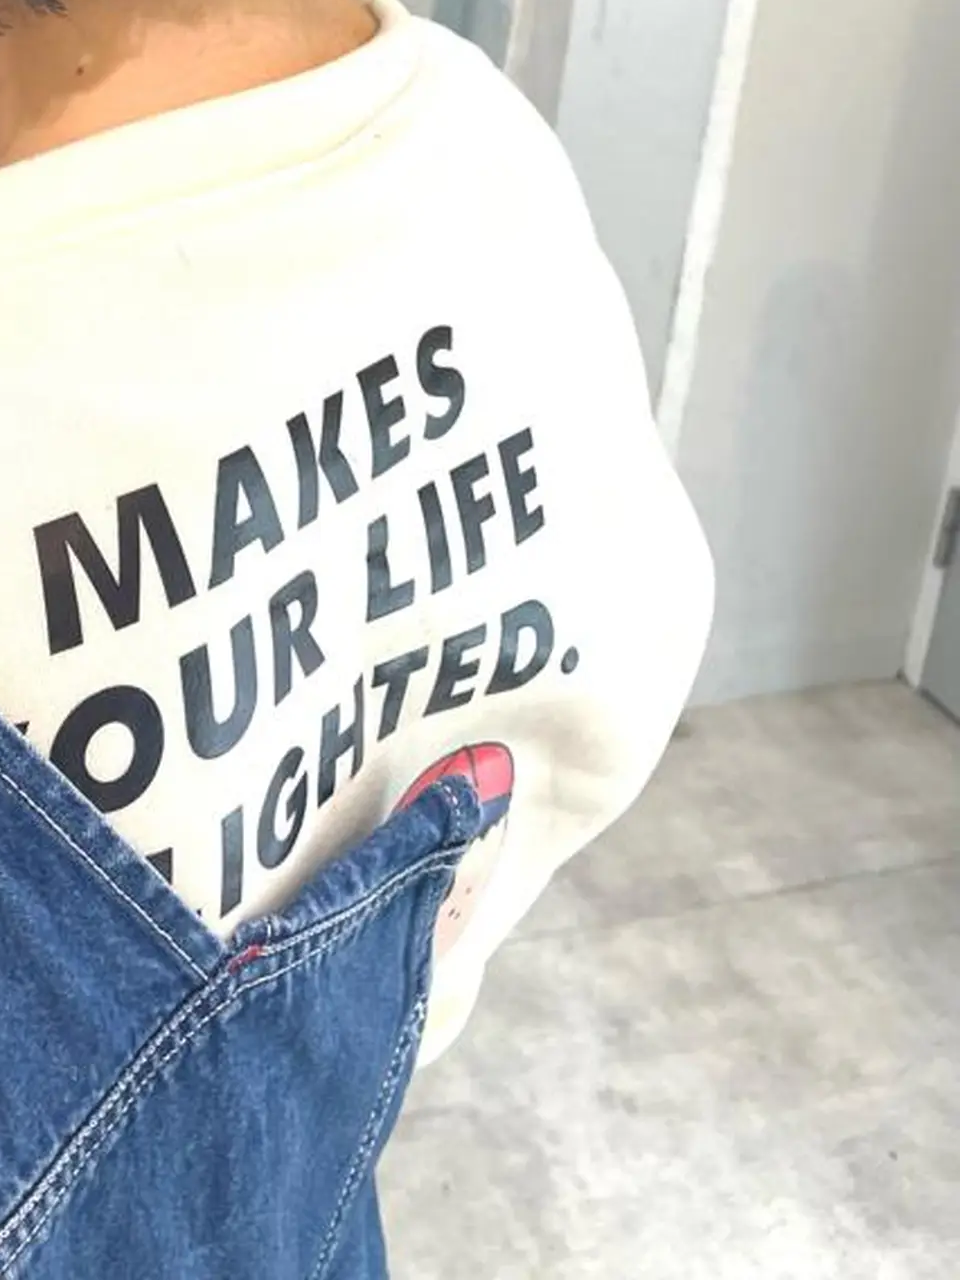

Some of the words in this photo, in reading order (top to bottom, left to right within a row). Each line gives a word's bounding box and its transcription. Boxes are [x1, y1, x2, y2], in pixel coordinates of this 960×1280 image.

[13, 569, 326, 815] OUR
[365, 426, 545, 623] LIFE
[33, 325, 466, 656] MAKES
[145, 599, 579, 919] IGHTED.
